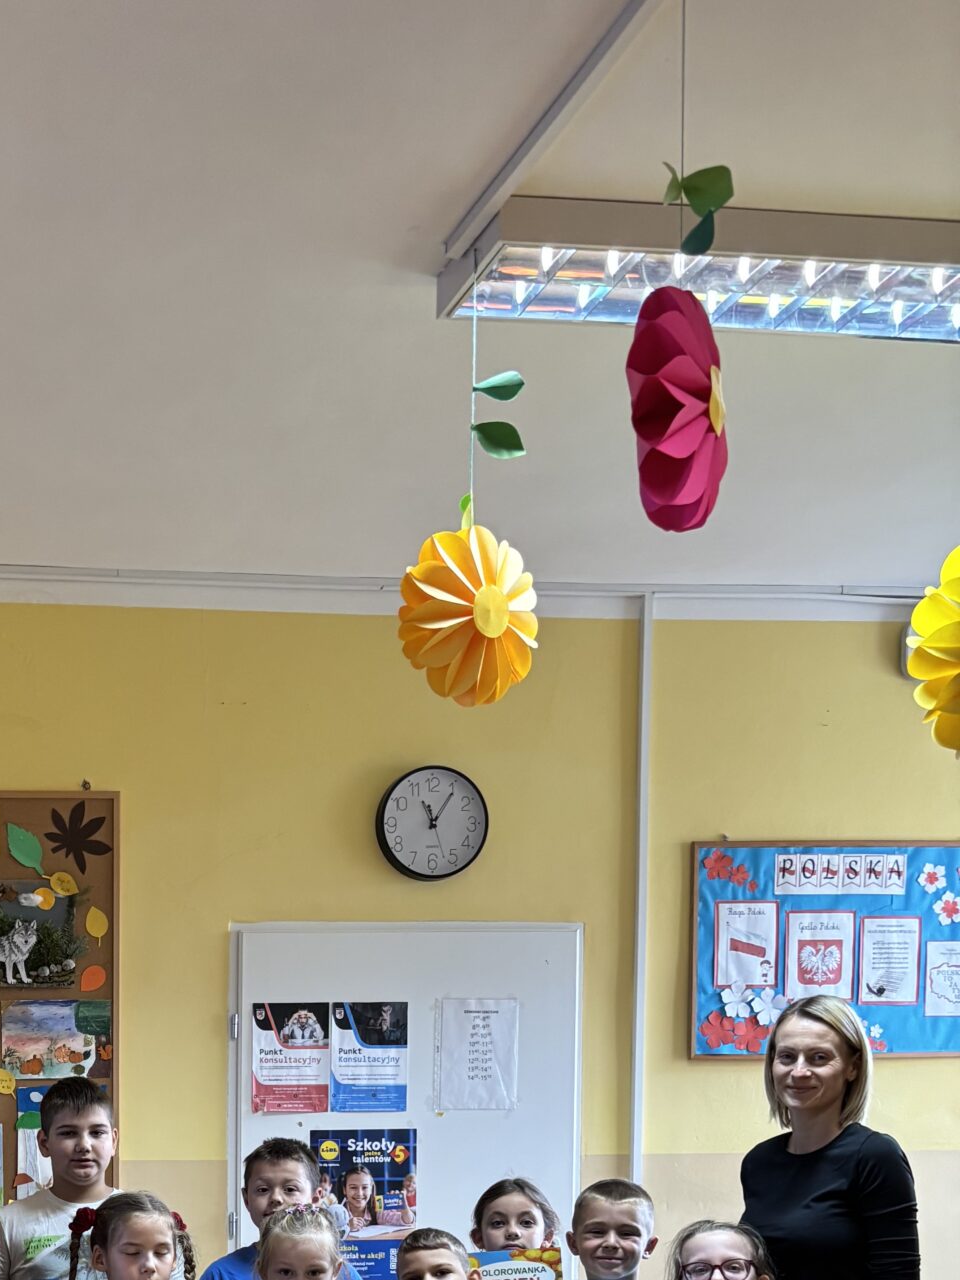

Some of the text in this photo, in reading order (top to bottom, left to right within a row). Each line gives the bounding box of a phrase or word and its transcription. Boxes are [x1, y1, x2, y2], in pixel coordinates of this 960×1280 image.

[409, 782, 420, 796] 11
[425, 777, 439, 792] 12
[449, 783, 453, 793] 1
[393, 797, 407, 811] 10
[461, 796, 470, 811] 2
[387, 817, 396, 833] 9
[467, 816, 476, 832] 3
[394, 836, 403, 852] 8
[461, 835, 470, 849] 4
[410, 851, 417, 865] 7
[428, 853, 437, 870] 6
[448, 849, 457, 864] 5
[781, 858, 901, 880] POLSKA
[259, 1056, 321, 1065] Konsultacyjny
[339, 1055, 400, 1064] Konsultacyjny
[348, 1138, 404, 1162] Szkoły 5
[353, 1155, 391, 1163] talentów
[482, 1266, 546, 1277] OLOROWANKA
